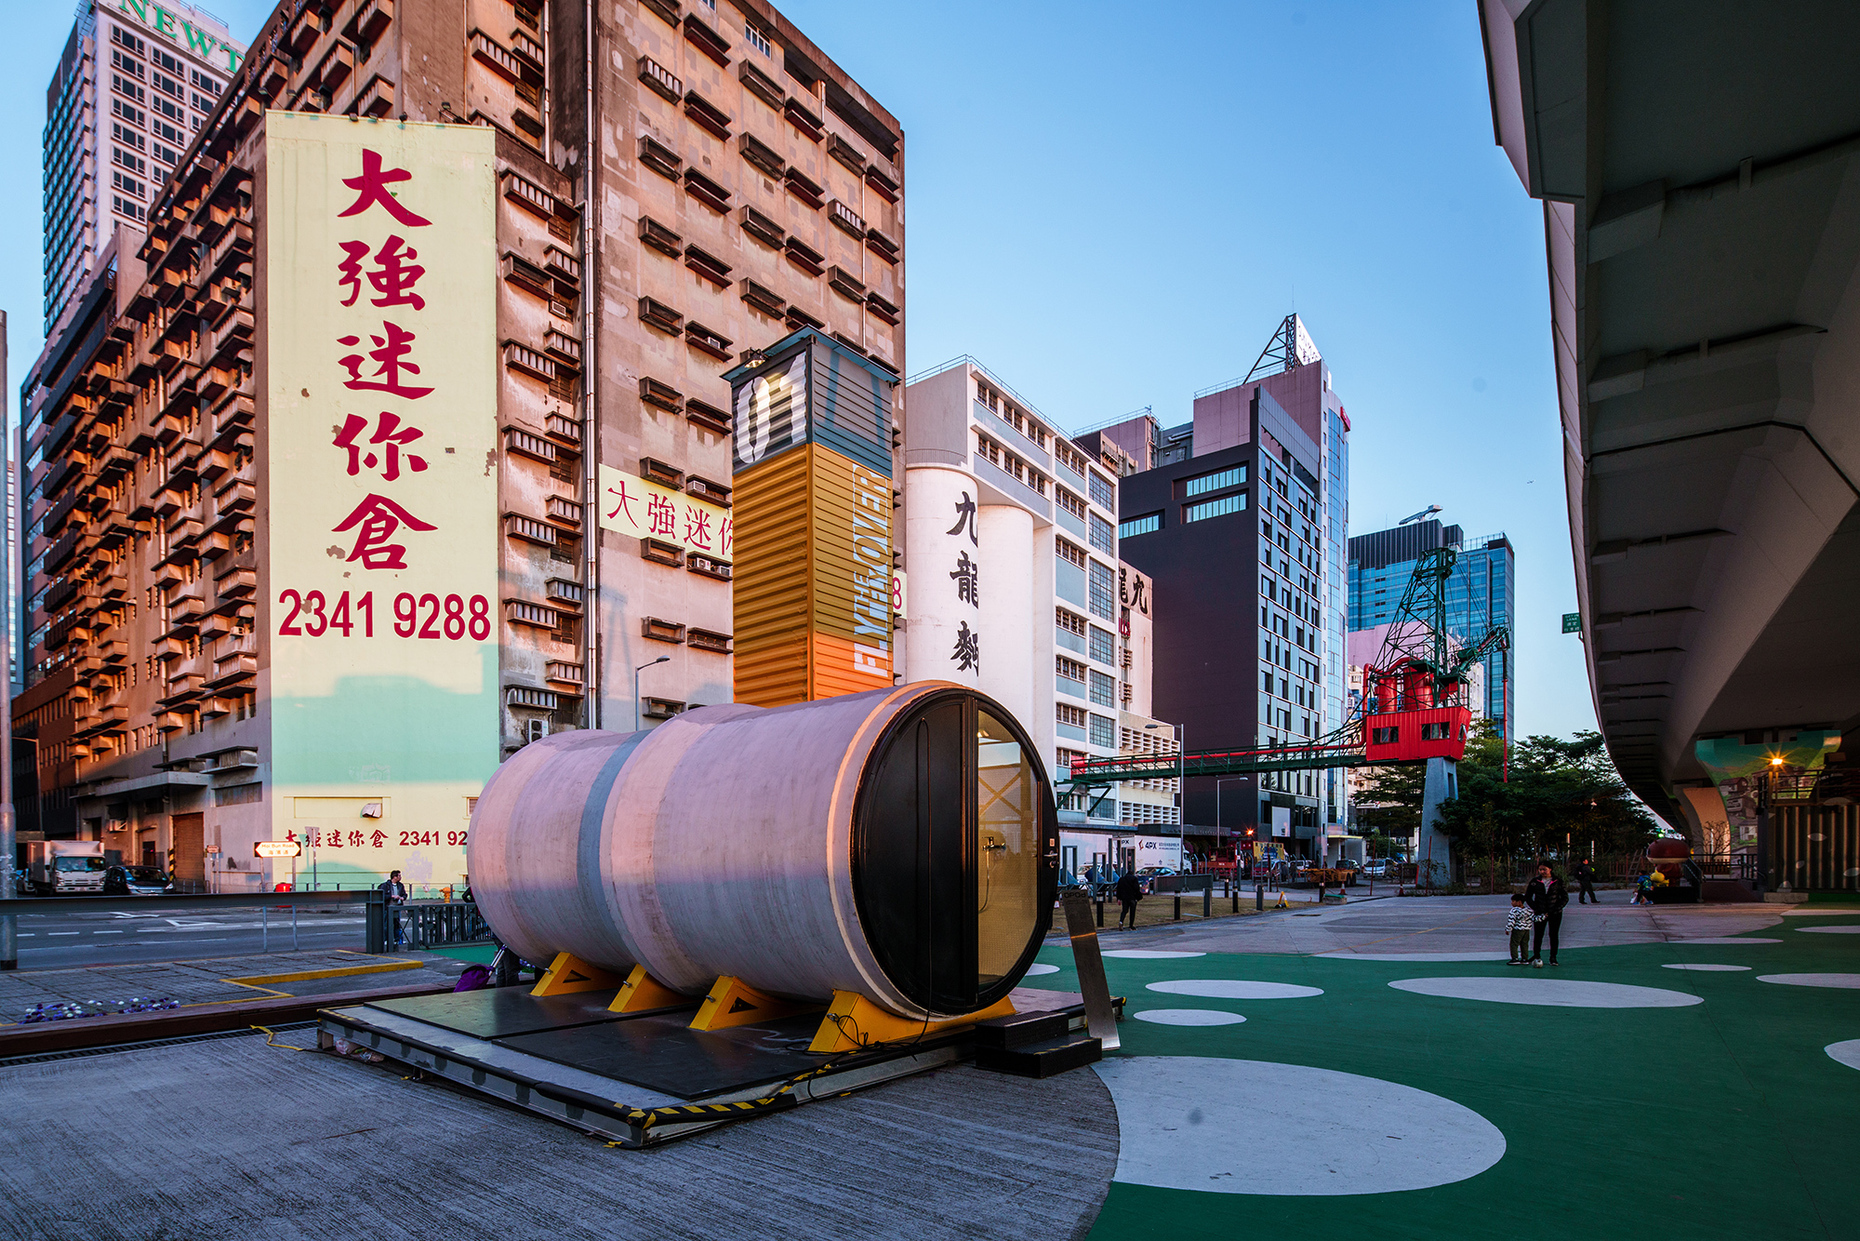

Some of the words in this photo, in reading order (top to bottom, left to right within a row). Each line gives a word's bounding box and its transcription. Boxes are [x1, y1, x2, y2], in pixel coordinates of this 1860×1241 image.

[331, 148, 439, 570] 大強迷你倉
[853, 570, 870, 612] THE
[278, 588, 374, 638] 2341
[393, 591, 491, 641] 9288
[399, 831, 440, 846] 2341
[1145, 841, 1157, 850] 4PX
